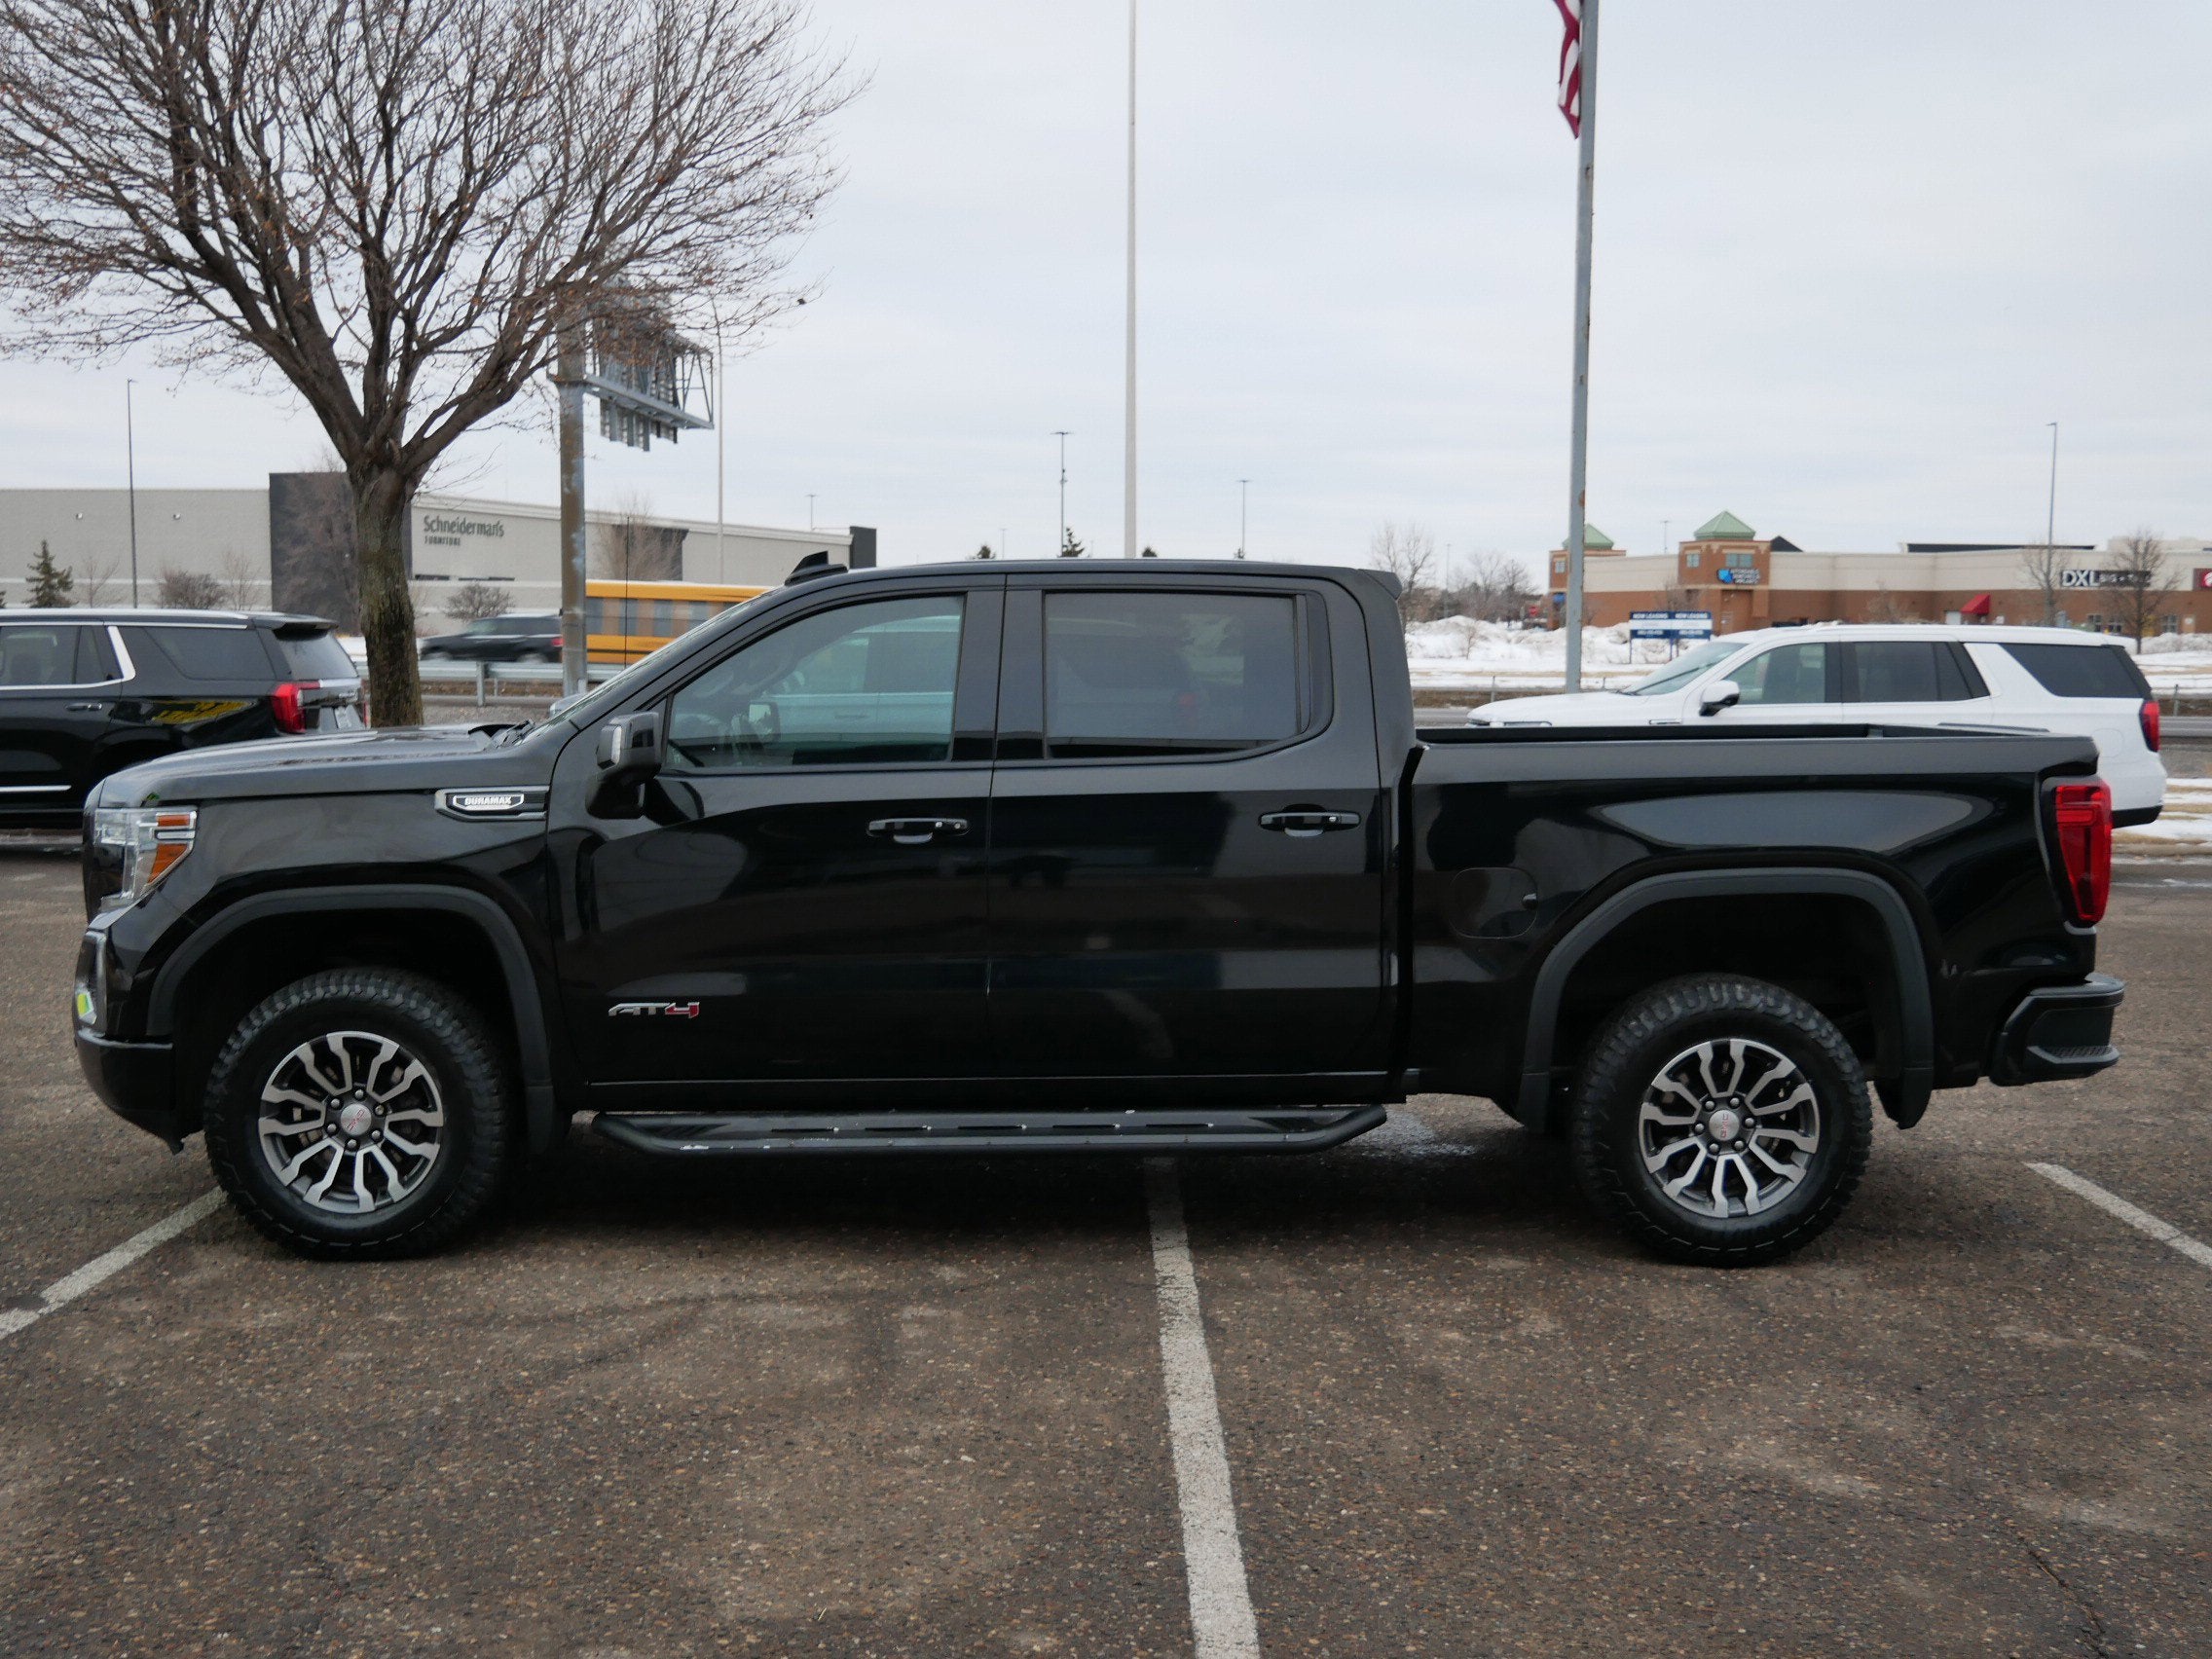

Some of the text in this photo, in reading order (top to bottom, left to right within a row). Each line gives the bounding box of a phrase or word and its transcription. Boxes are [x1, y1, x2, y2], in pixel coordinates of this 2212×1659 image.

[424, 515, 504, 537] Schneiderman's
[2062, 570, 2100, 587] DXL
[464, 796, 512, 806] DURAMAX
[608, 1002, 700, 1018] AT4
